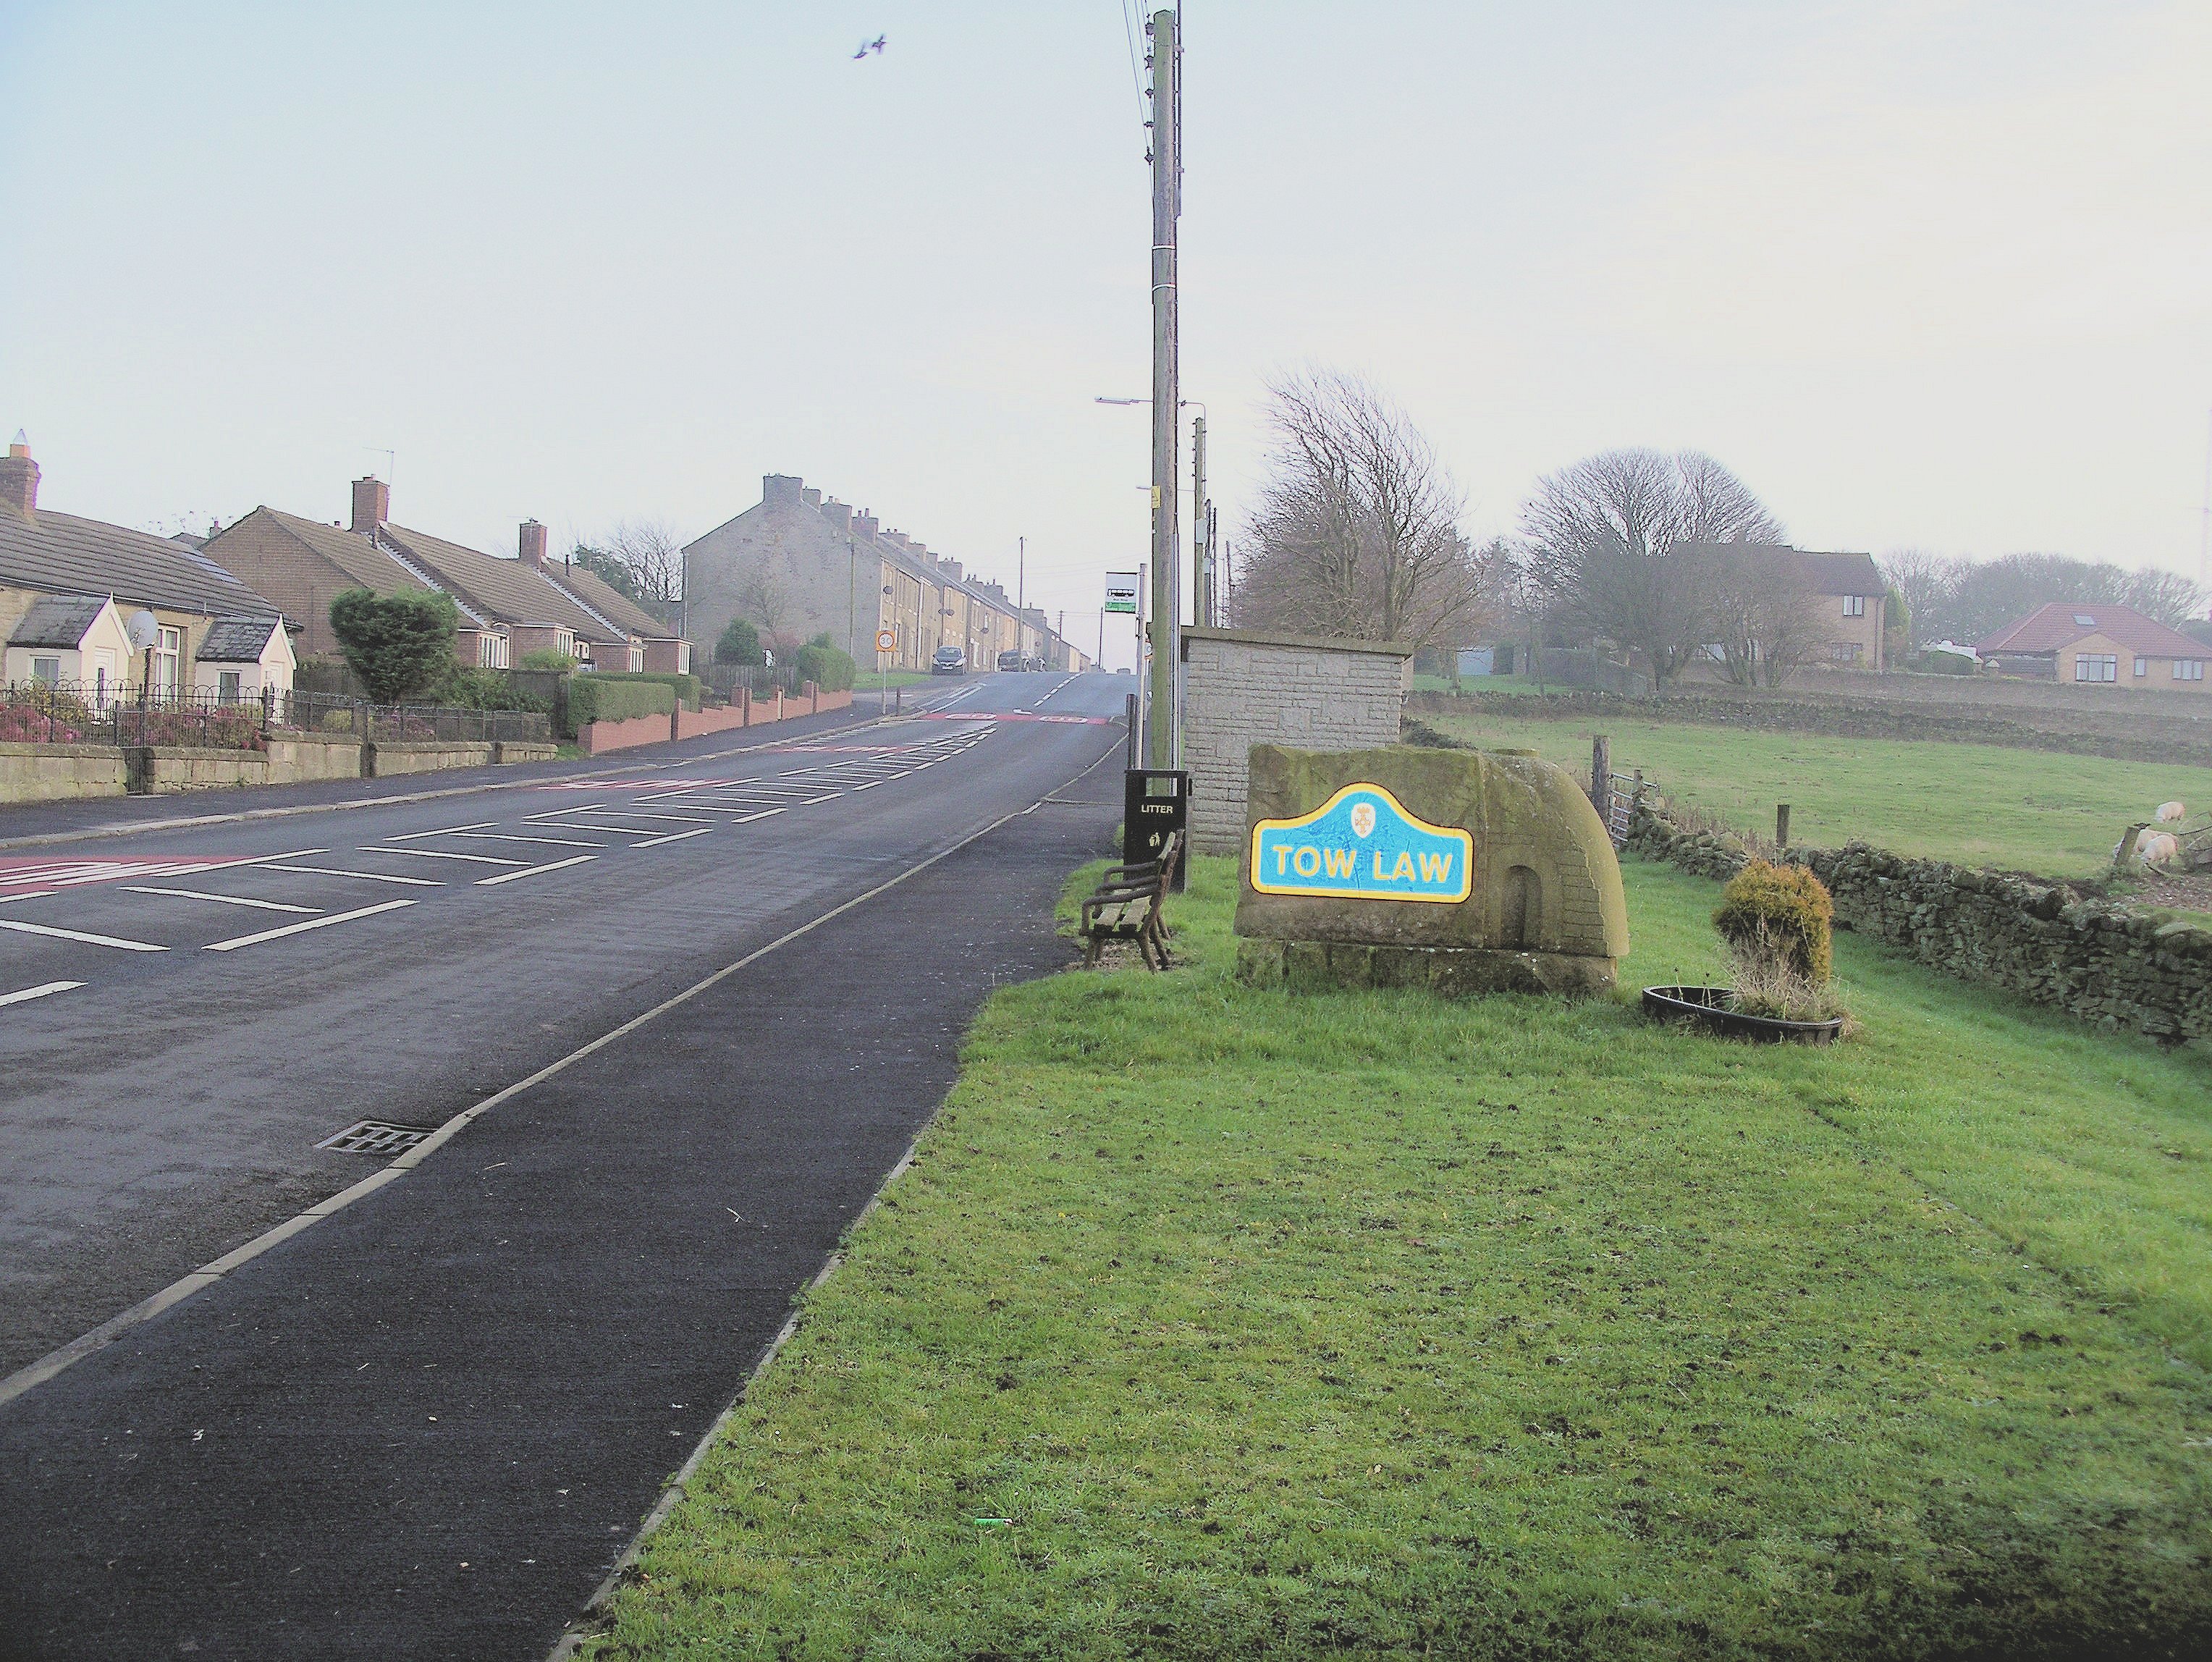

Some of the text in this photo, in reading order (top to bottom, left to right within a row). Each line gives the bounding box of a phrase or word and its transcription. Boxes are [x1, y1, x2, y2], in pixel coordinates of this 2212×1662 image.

[1141, 804, 1174, 814] LITTER
[1272, 845, 1453, 883] TOW LAW
